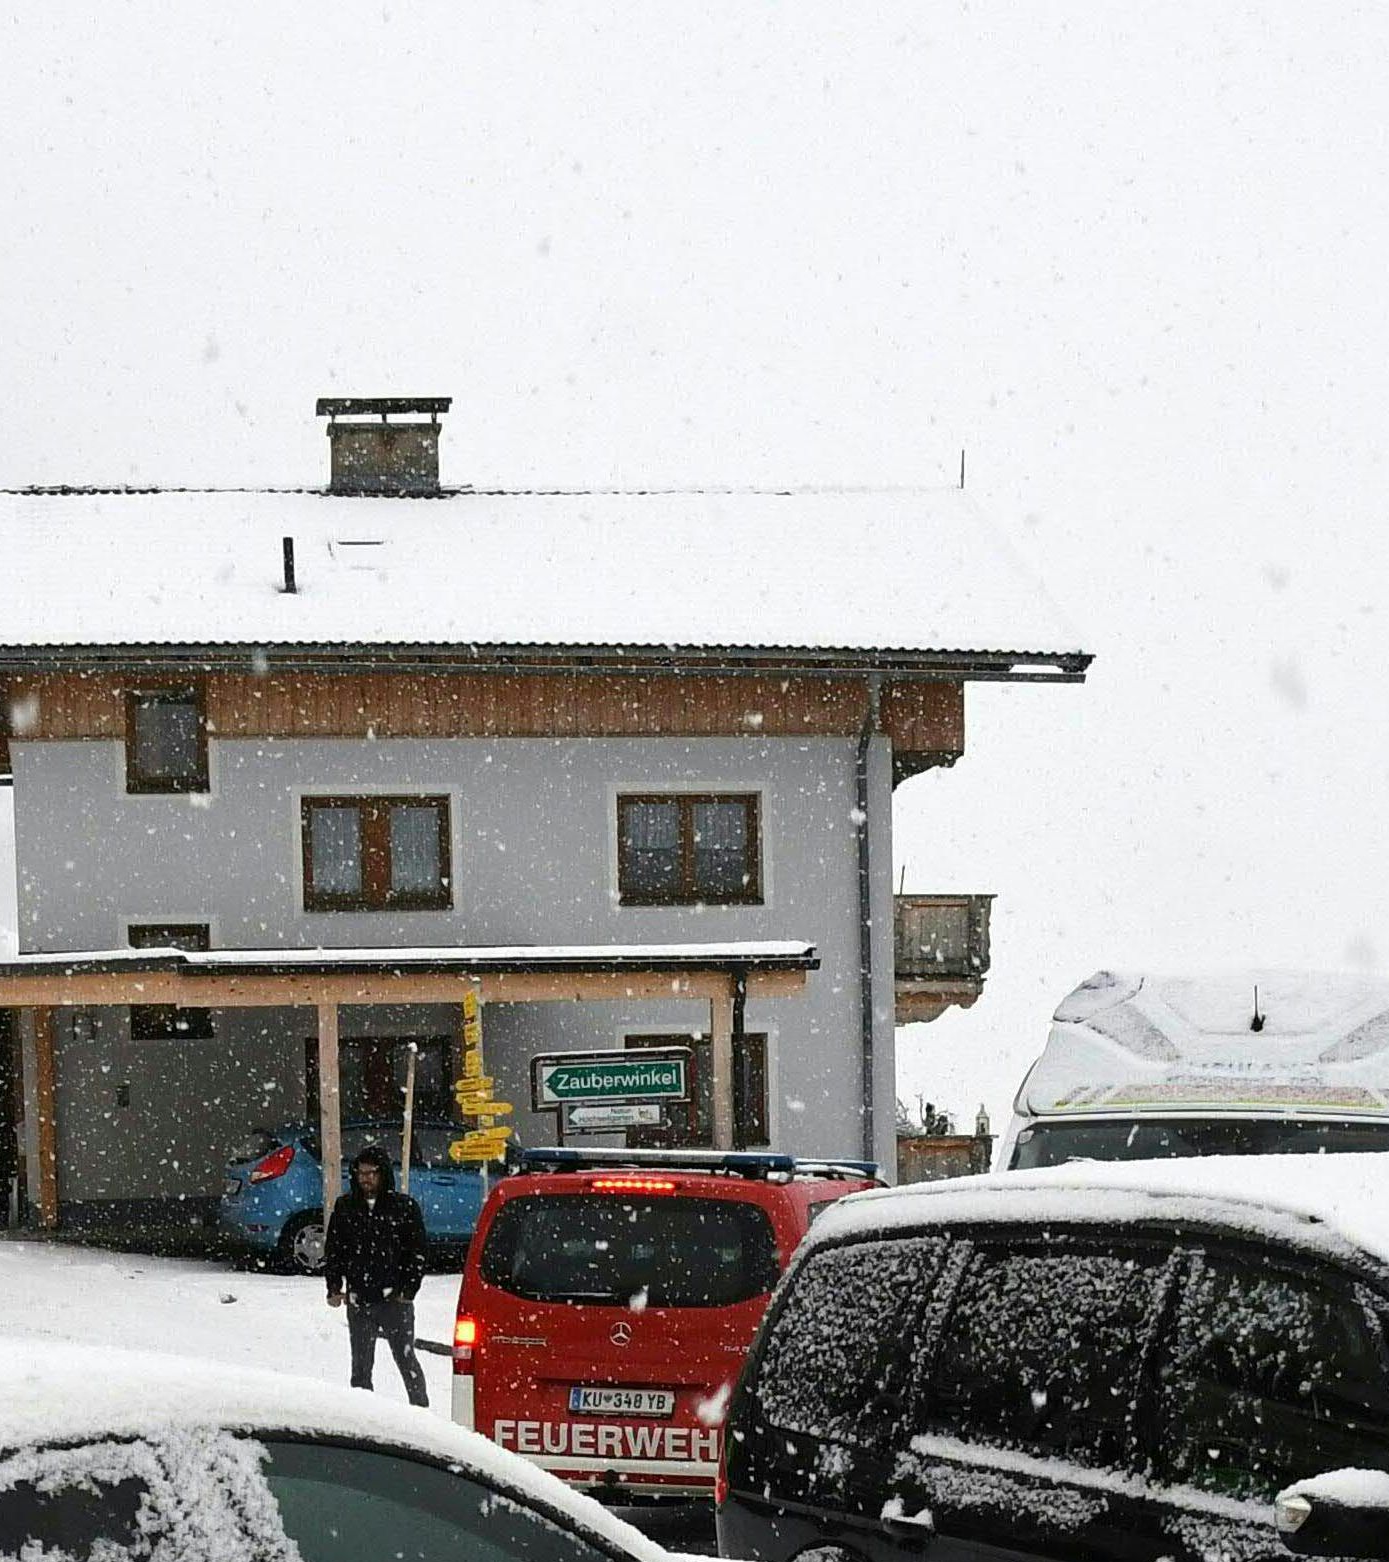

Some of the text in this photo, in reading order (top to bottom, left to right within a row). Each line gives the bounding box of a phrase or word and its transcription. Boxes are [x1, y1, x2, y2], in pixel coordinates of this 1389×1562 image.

[557, 1069, 677, 1090] Zauberwinkel
[582, 1391, 602, 1408] KU
[647, 1393, 666, 1410] YB
[494, 1419, 719, 1461] FEUERWEH
